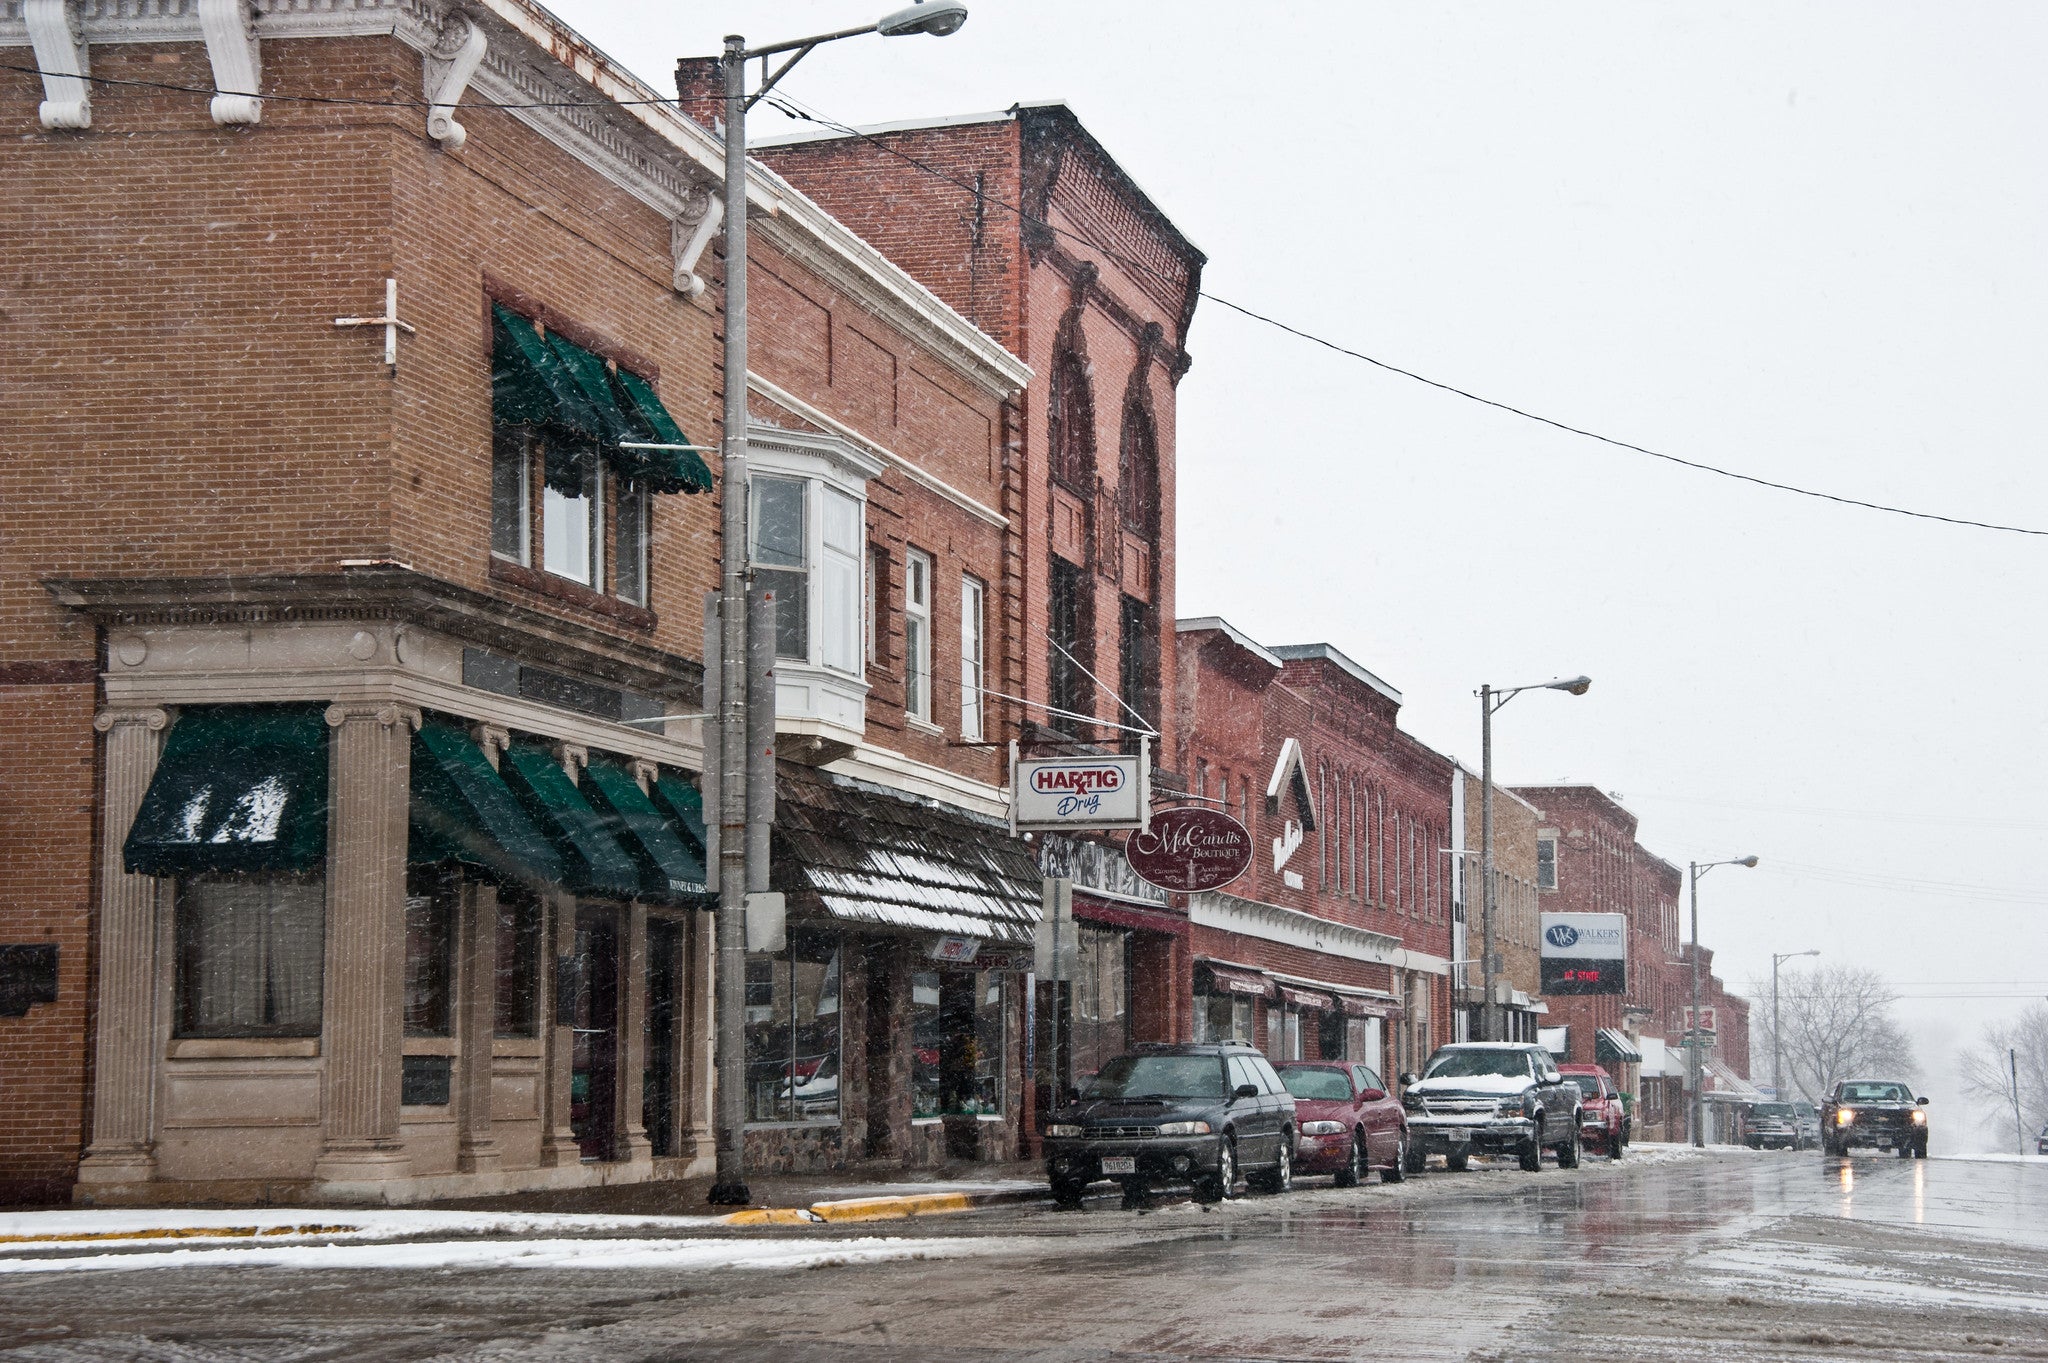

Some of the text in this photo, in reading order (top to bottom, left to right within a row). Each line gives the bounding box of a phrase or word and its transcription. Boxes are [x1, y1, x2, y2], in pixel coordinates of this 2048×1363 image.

[1037, 770, 1118, 792] HARTIG
[1057, 795, 1101, 816] Drug
[1193, 847, 1241, 858] BOUTIQUE
[1577, 928, 1620, 938] WALKER'S
